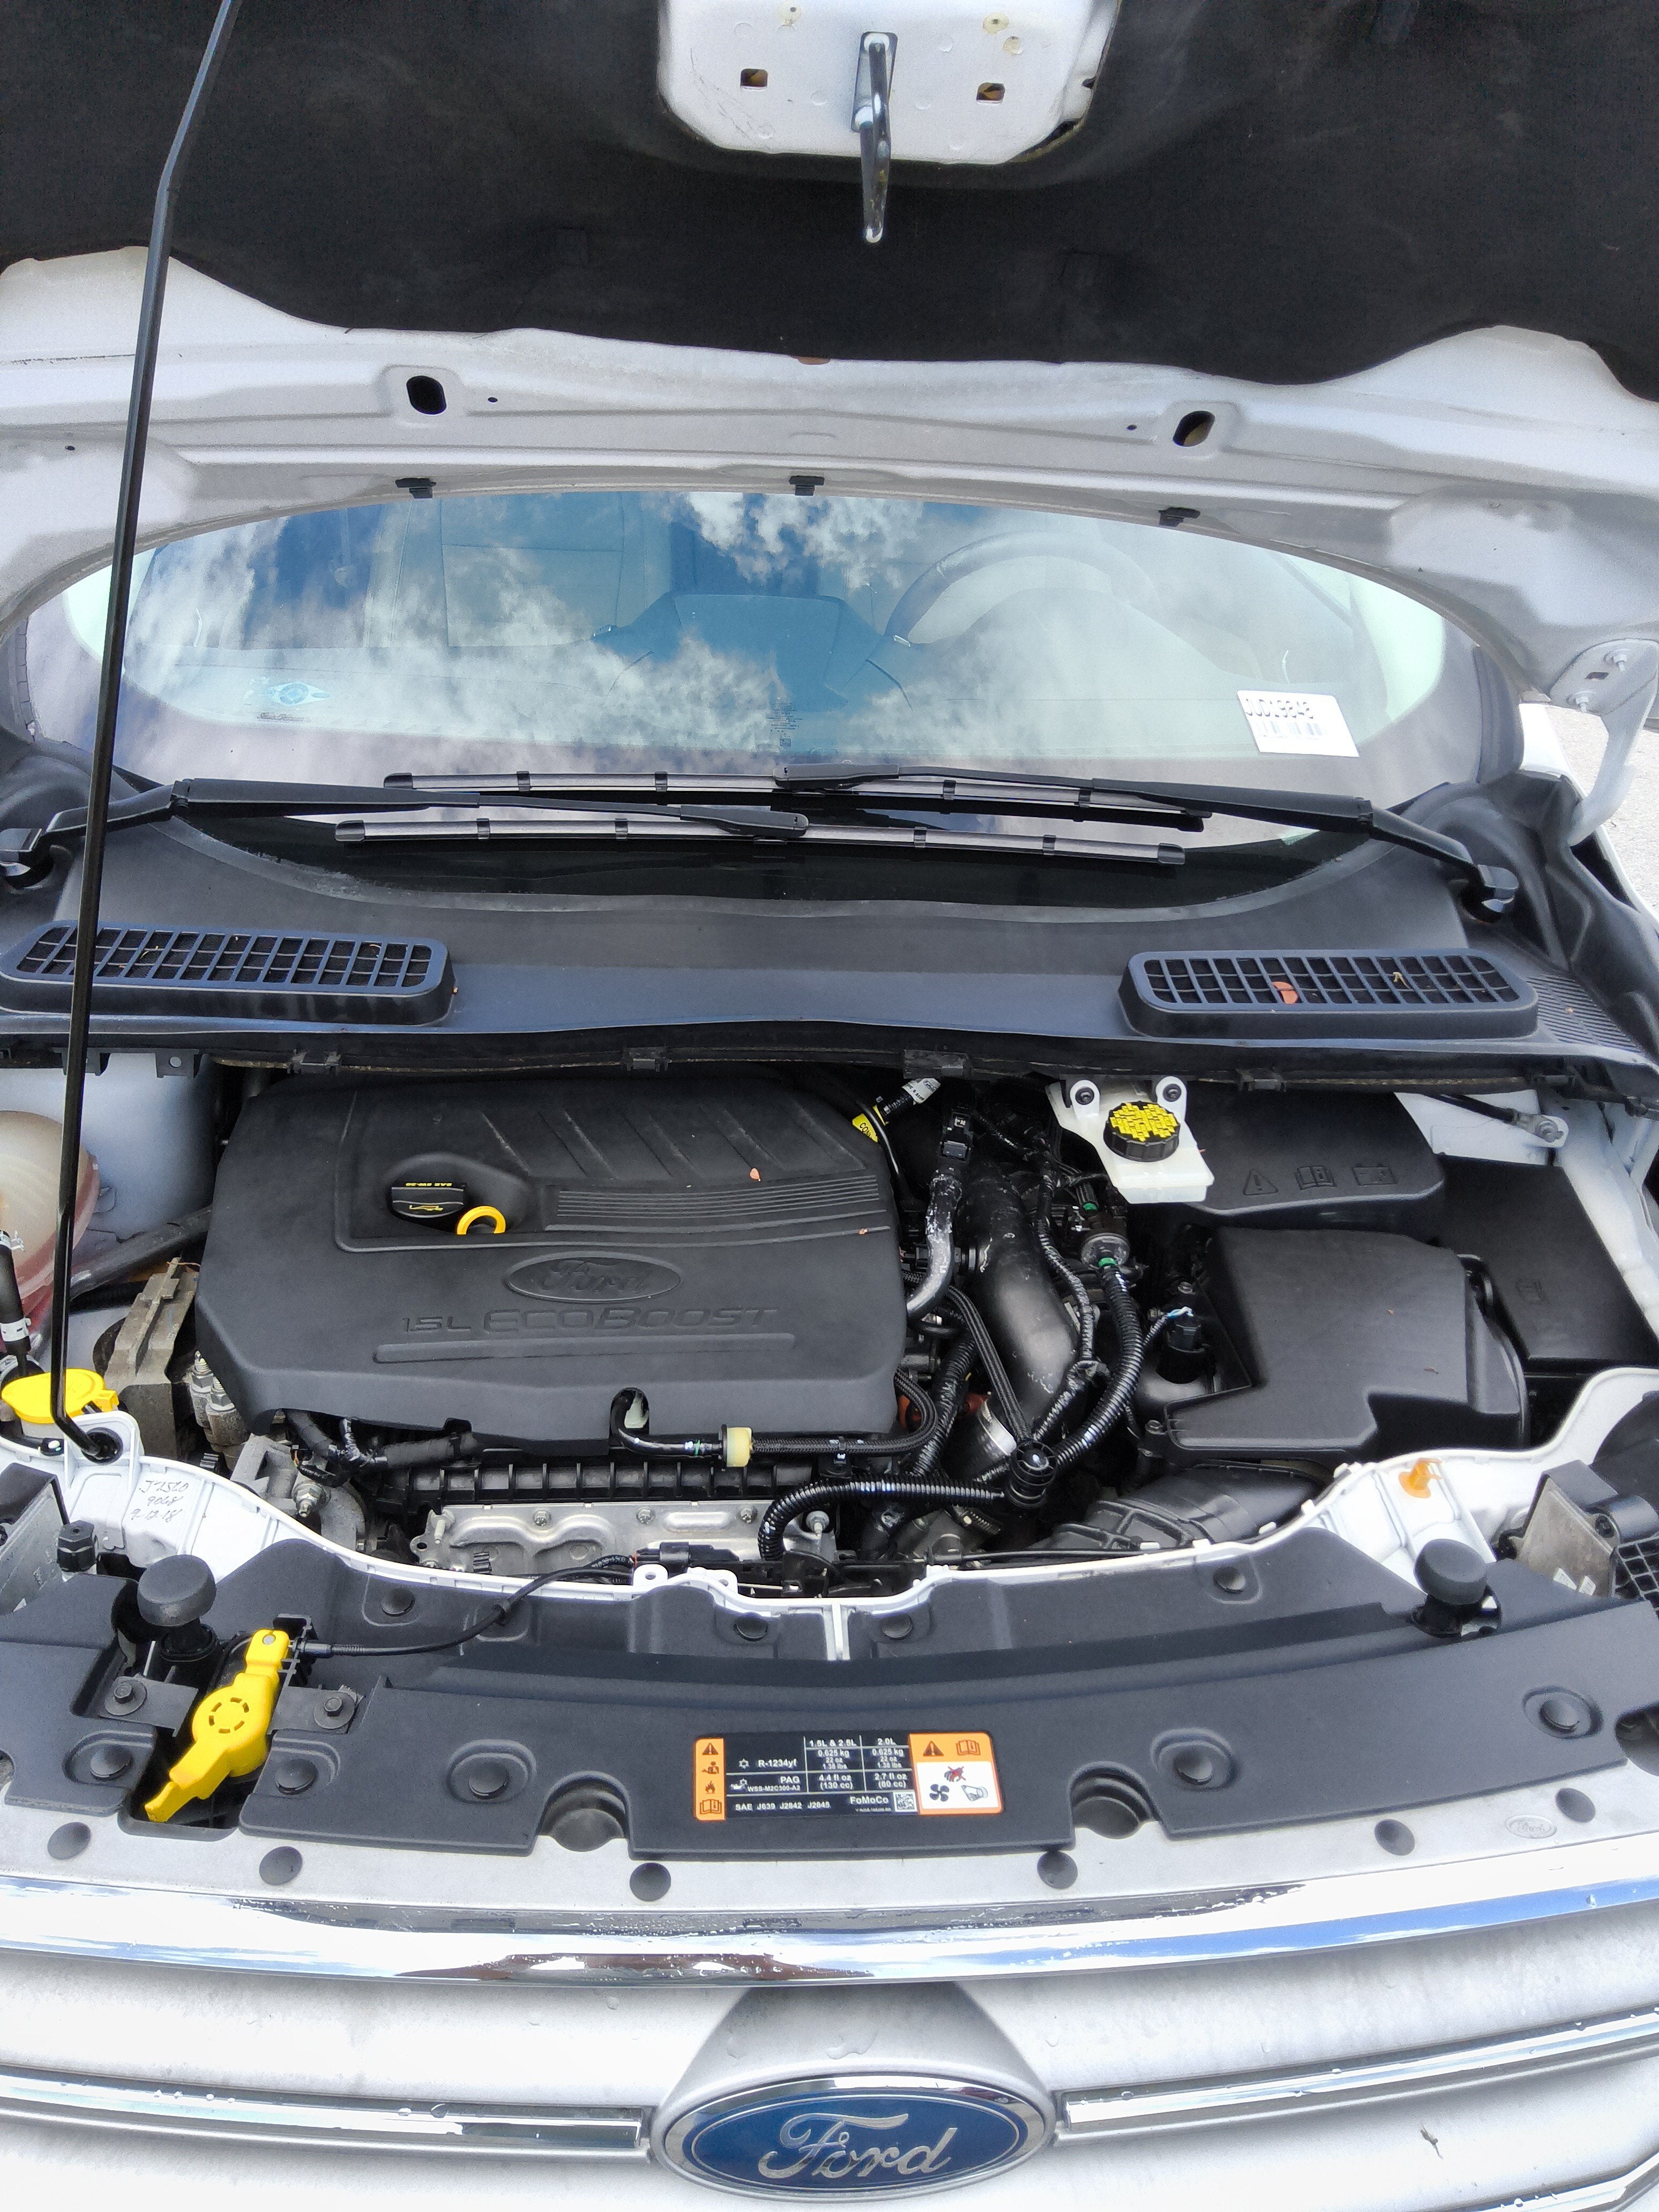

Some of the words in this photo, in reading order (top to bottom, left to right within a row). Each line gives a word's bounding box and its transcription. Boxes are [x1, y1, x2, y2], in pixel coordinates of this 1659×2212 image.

[537, 1259, 651, 1293] Ford
[877, 1738, 896, 1746] 2.0L
[840, 1749, 850, 1758] kg
[894, 1748, 904, 1757] kg
[758, 1758, 797, 1768] R-1234yf
[780, 1776, 801, 1784] PAG
[893, 1780, 906, 1789] cc)
[820, 1782, 838, 1790] (130
[840, 1782, 853, 1790] cc)
[850, 1796, 889, 1805] FoMoCo
[735, 1803, 753, 1811] SAE
[758, 2112, 958, 2179] Ford
